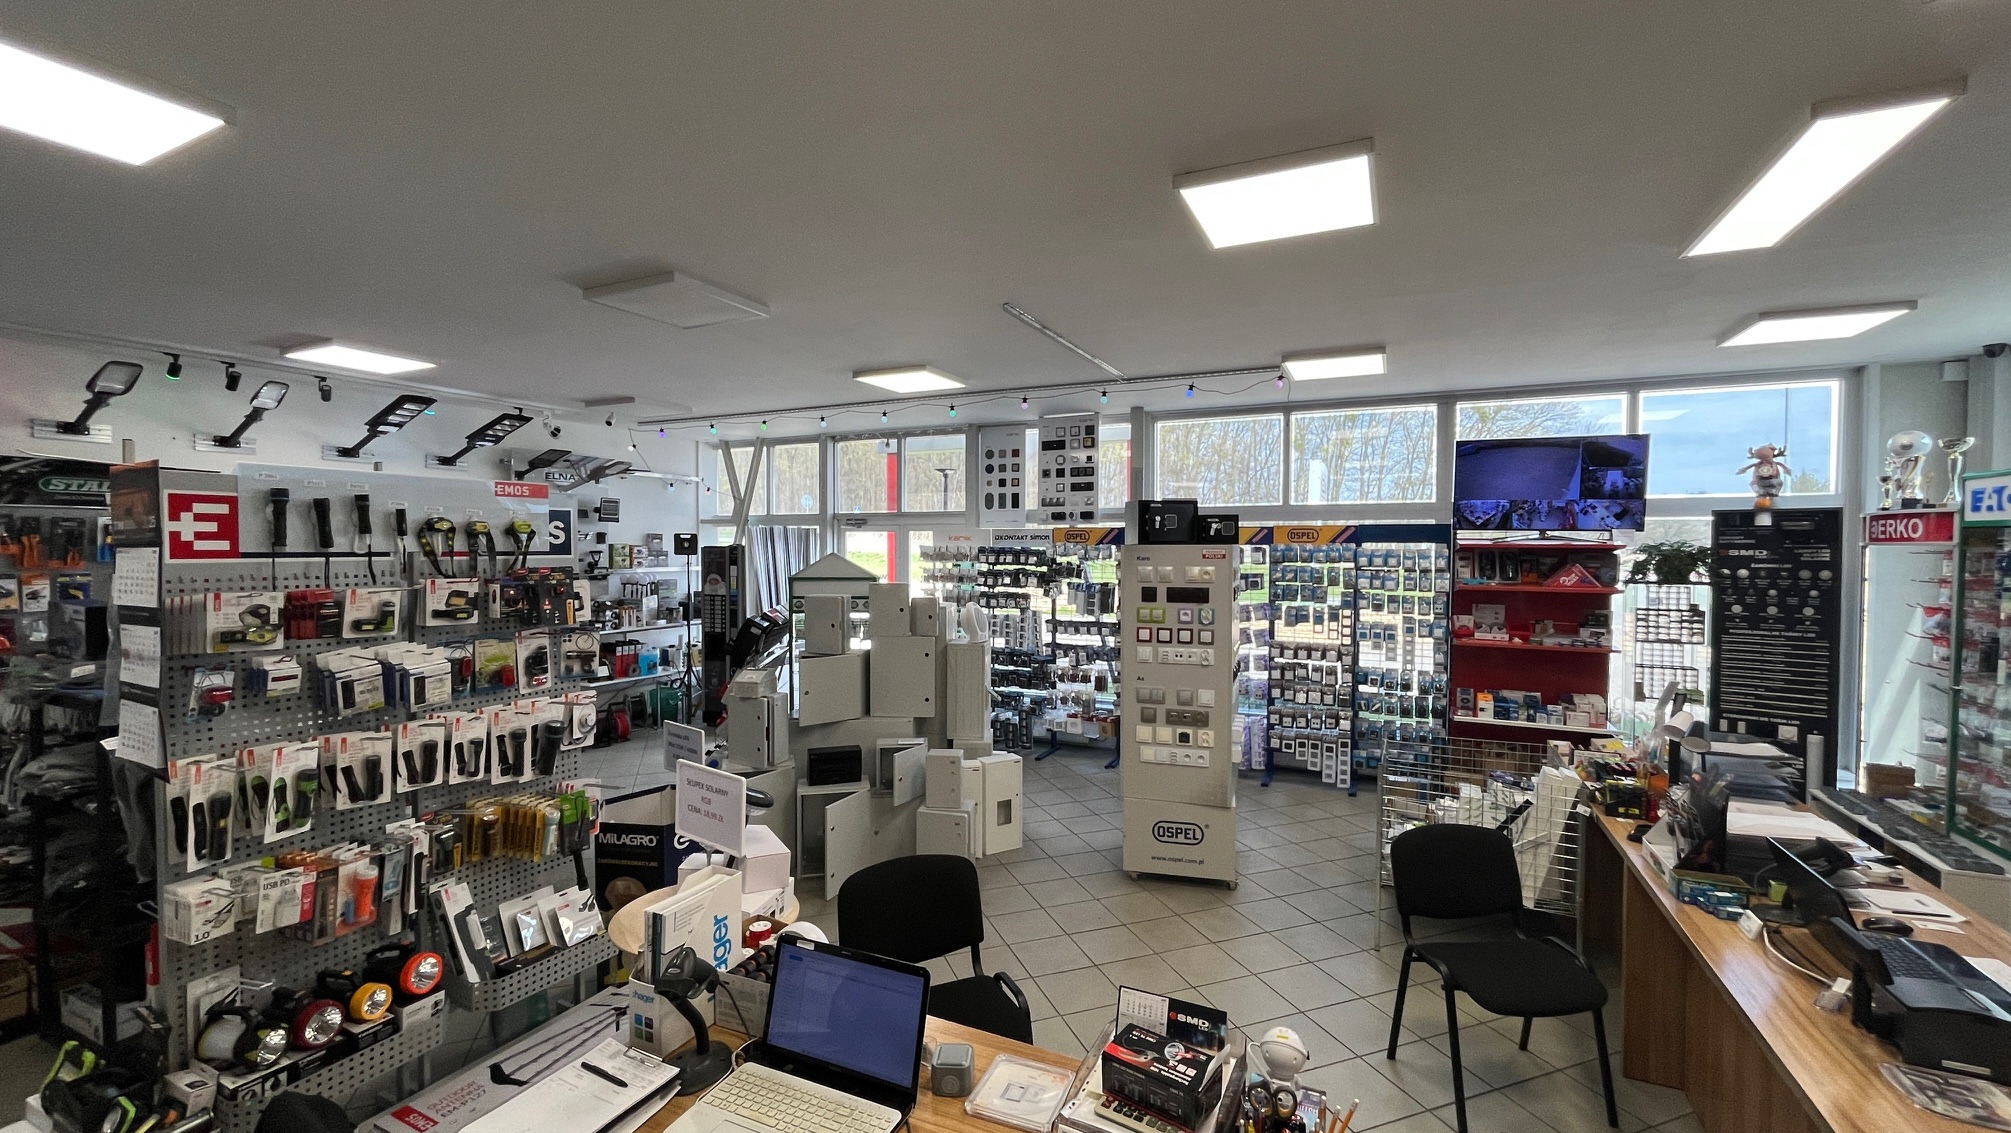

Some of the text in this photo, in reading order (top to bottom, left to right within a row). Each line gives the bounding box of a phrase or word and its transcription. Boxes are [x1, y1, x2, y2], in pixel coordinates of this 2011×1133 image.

[496, 484, 530, 496] EMOS
[1030, 533, 1050, 541] simon
[1066, 532, 1088, 542] OSPEL
[1289, 530, 1316, 541] OSPEL
[705, 784, 729, 798] SOLARNY
[1156, 825, 1200, 841] OSPEL
[1151, 855, 1205, 866] www.ospel.com.pl
[263, 878, 290, 891] USB PD
[1177, 1013, 1210, 1028] SMD
